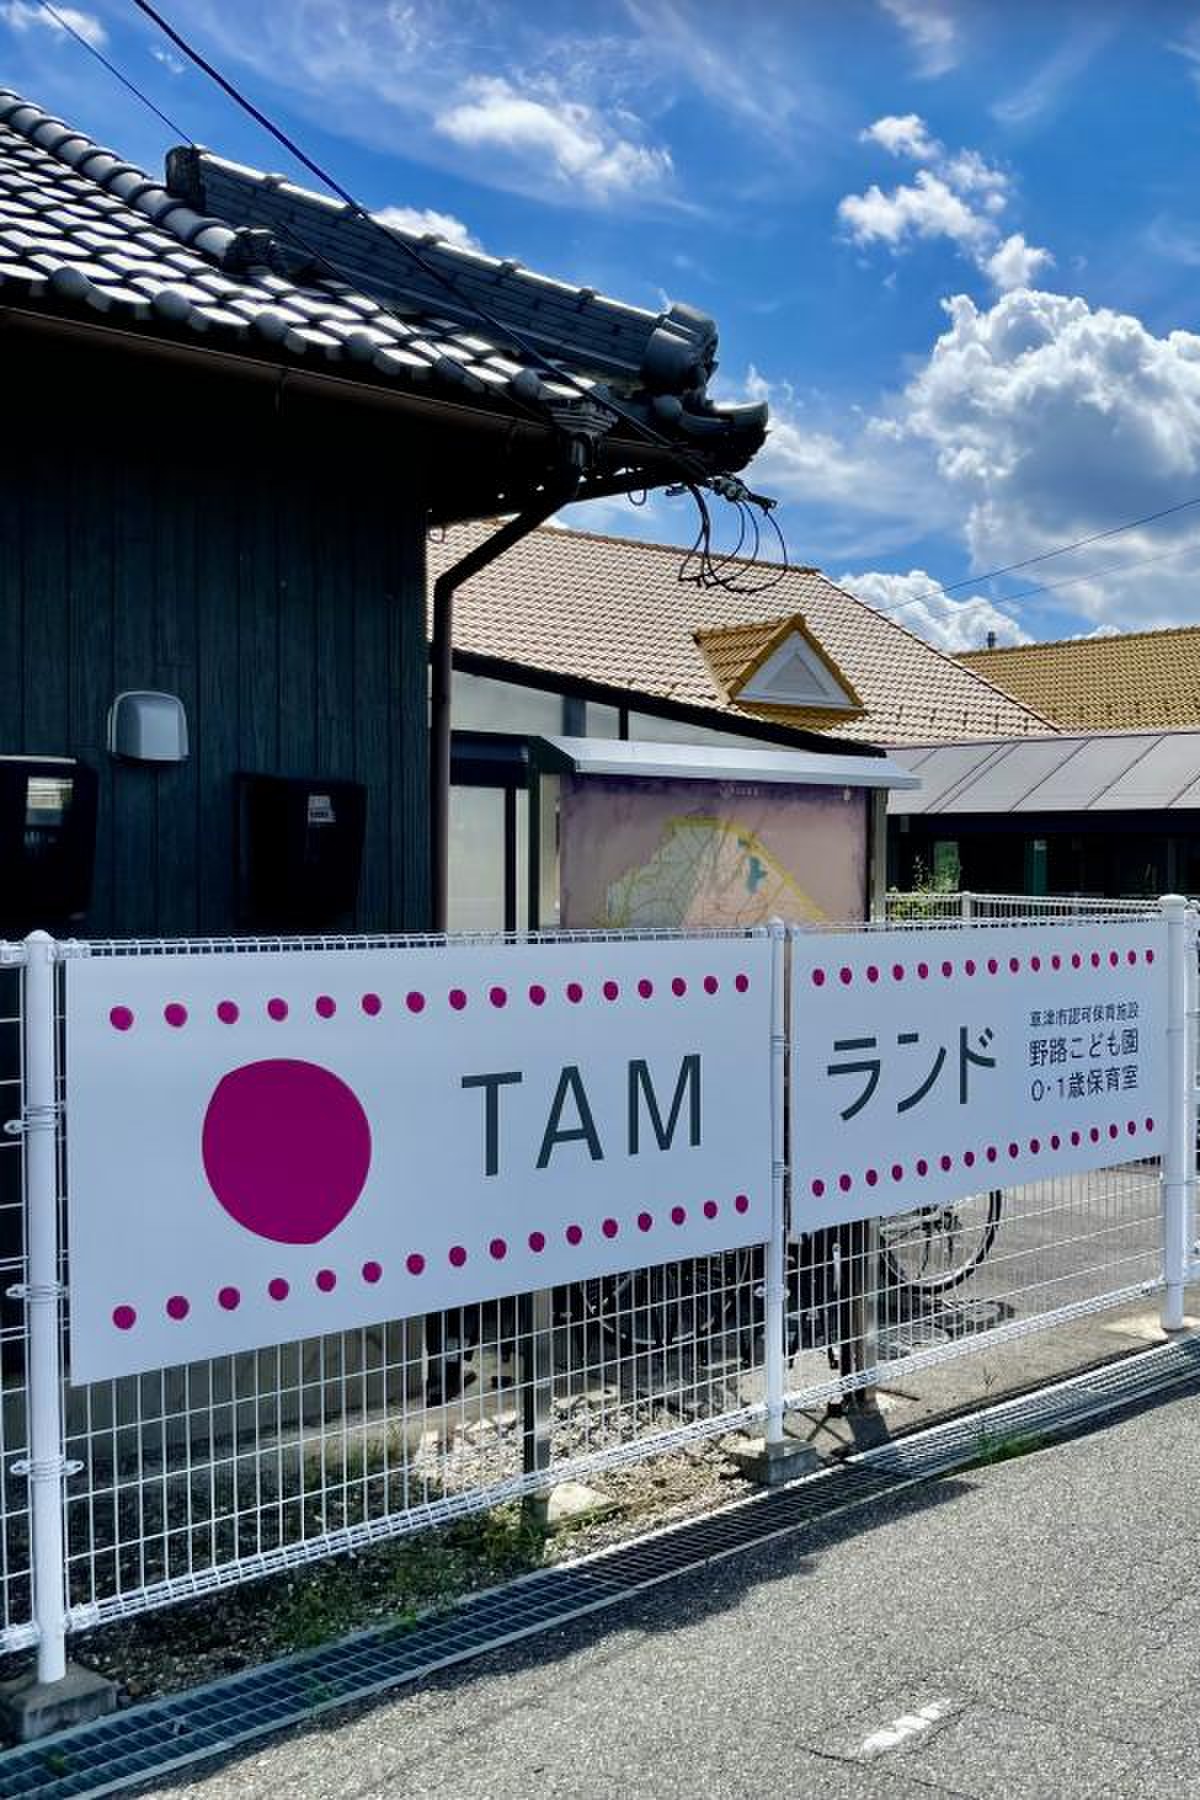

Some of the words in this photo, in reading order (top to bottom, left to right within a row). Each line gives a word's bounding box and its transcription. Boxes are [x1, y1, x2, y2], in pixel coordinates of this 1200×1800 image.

[827, 1026, 996, 1121] ランド
[1029, 1028, 1138, 1067] 野路こども園
[461, 1054, 702, 1176] TAM
